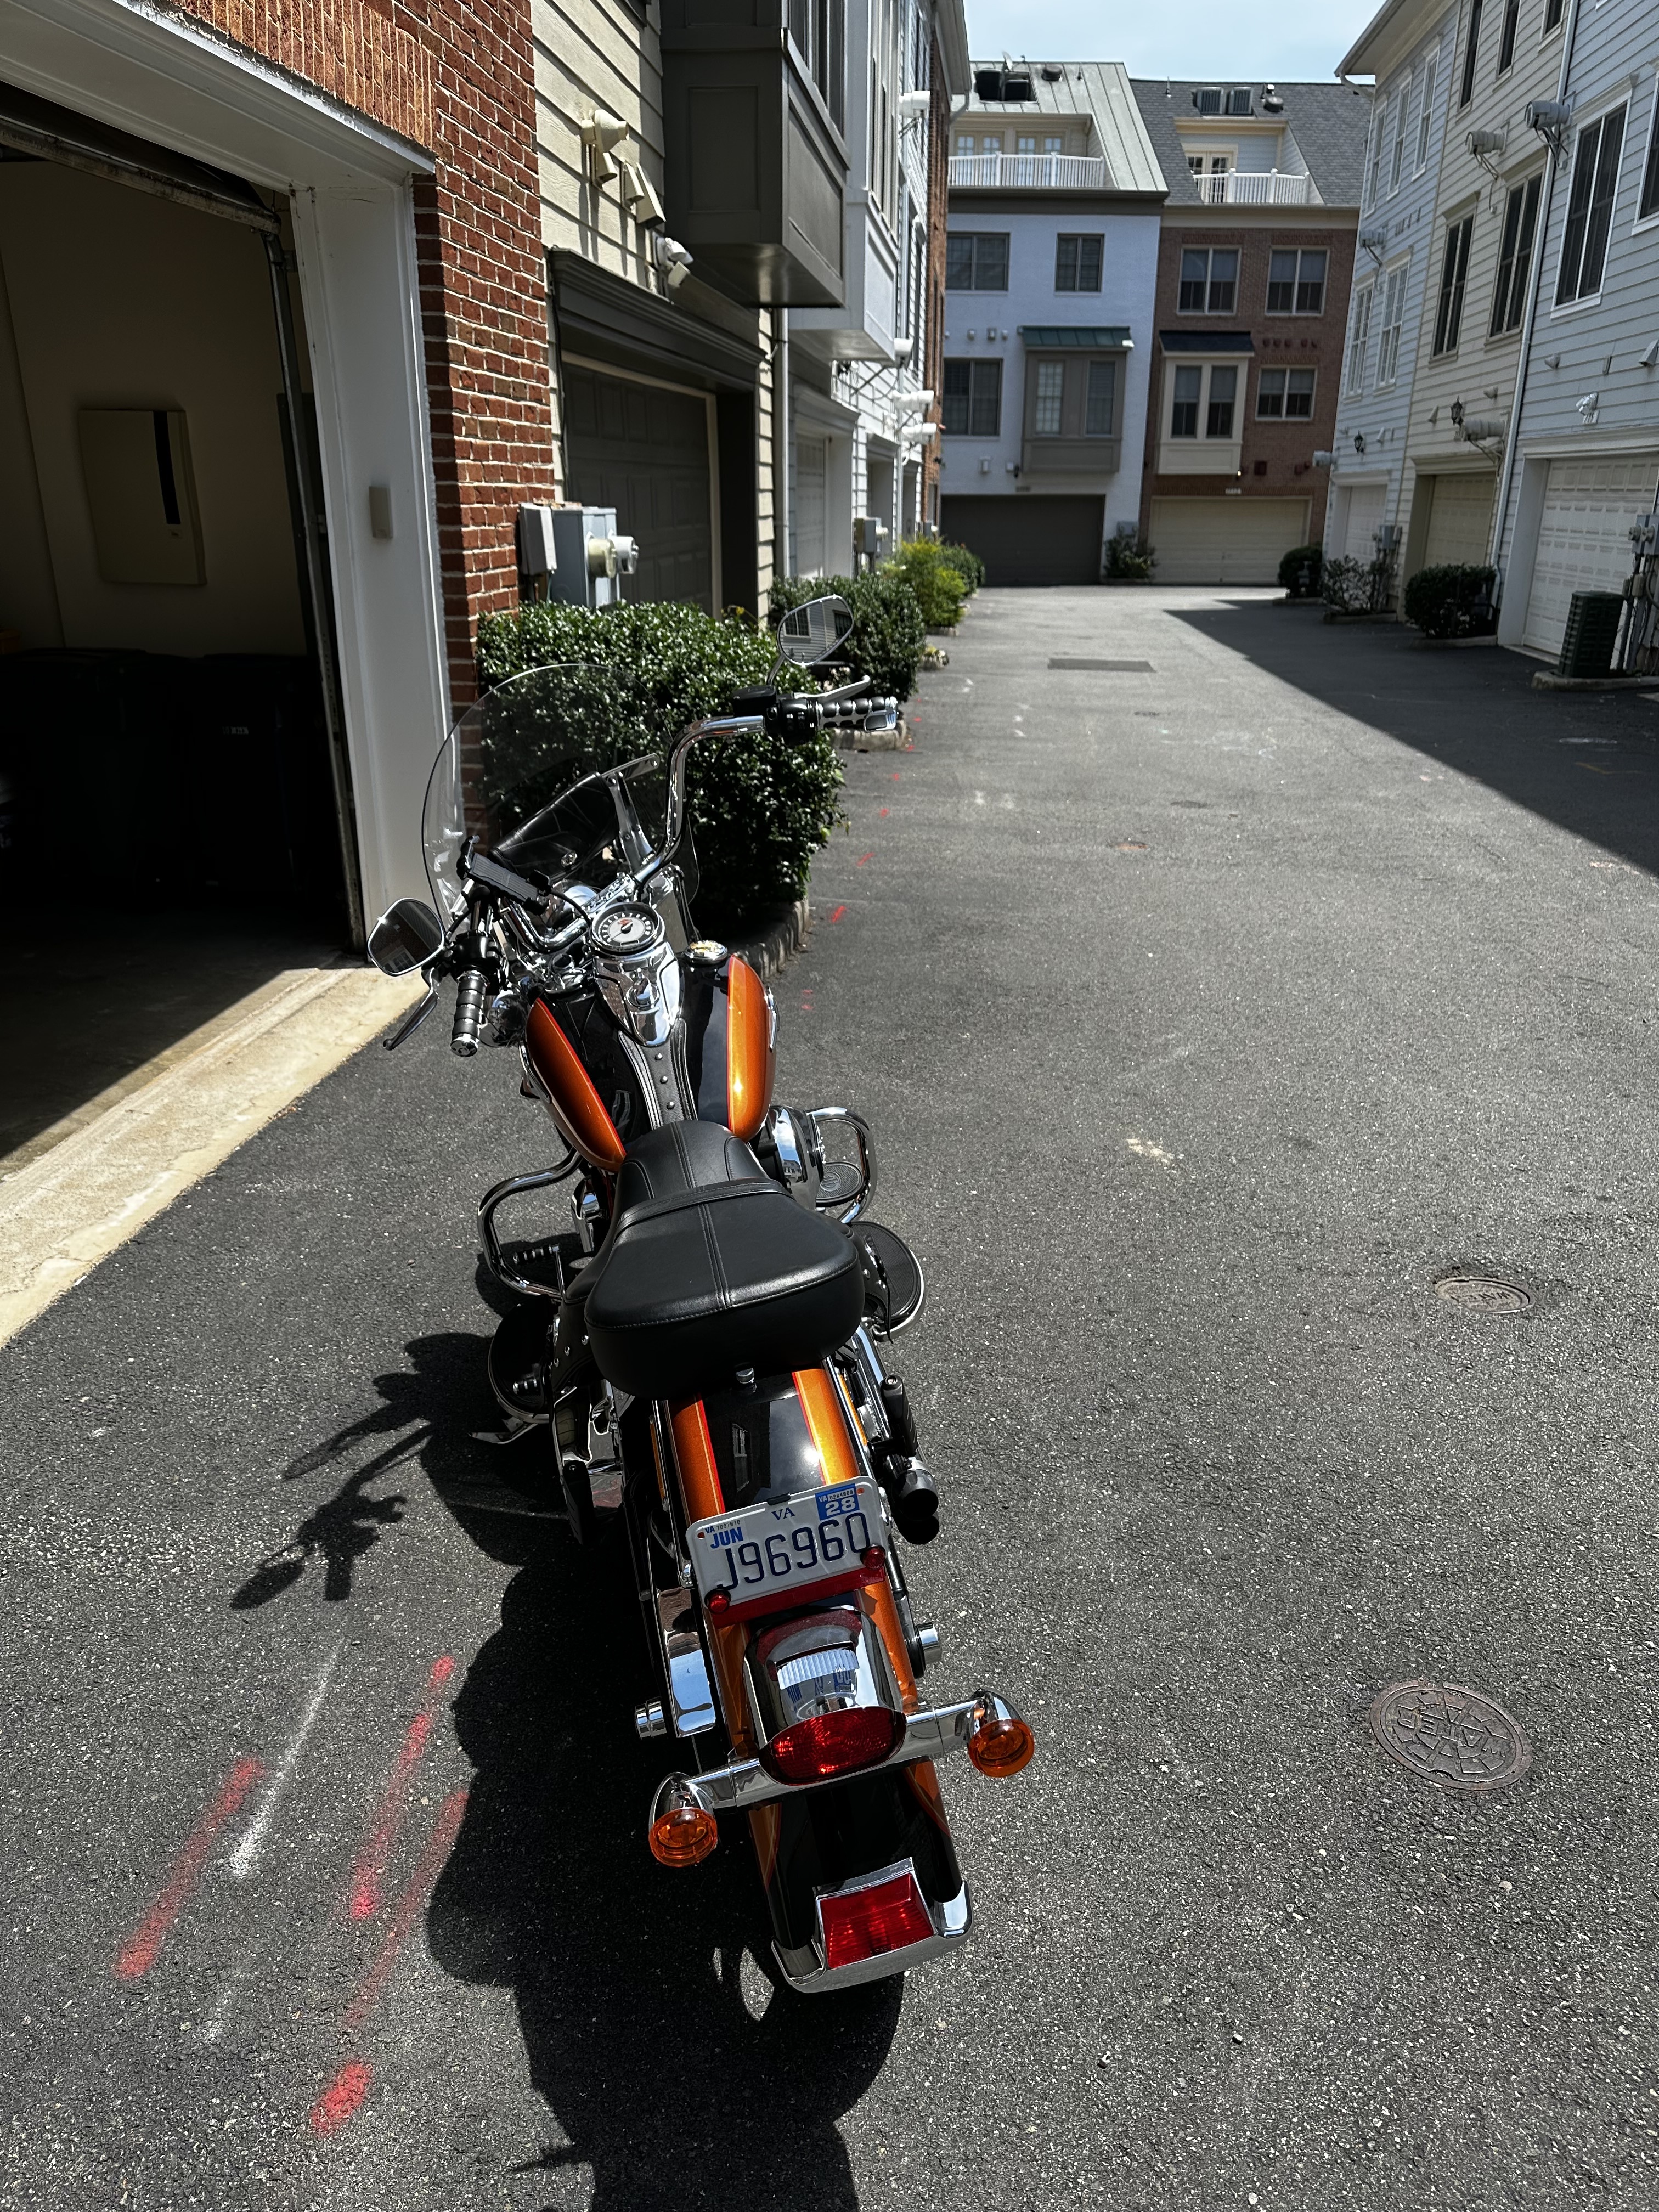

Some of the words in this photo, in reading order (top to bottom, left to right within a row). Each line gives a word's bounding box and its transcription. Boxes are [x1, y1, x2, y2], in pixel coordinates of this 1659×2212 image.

[771, 1506, 796, 1521] VA
[825, 1497, 856, 1516] 28
[705, 1526, 715, 1534] VA
[716, 1520, 741, 1531] 7097610
[710, 1526, 744, 1549] JUN
[716, 1513, 871, 1590] J96960
